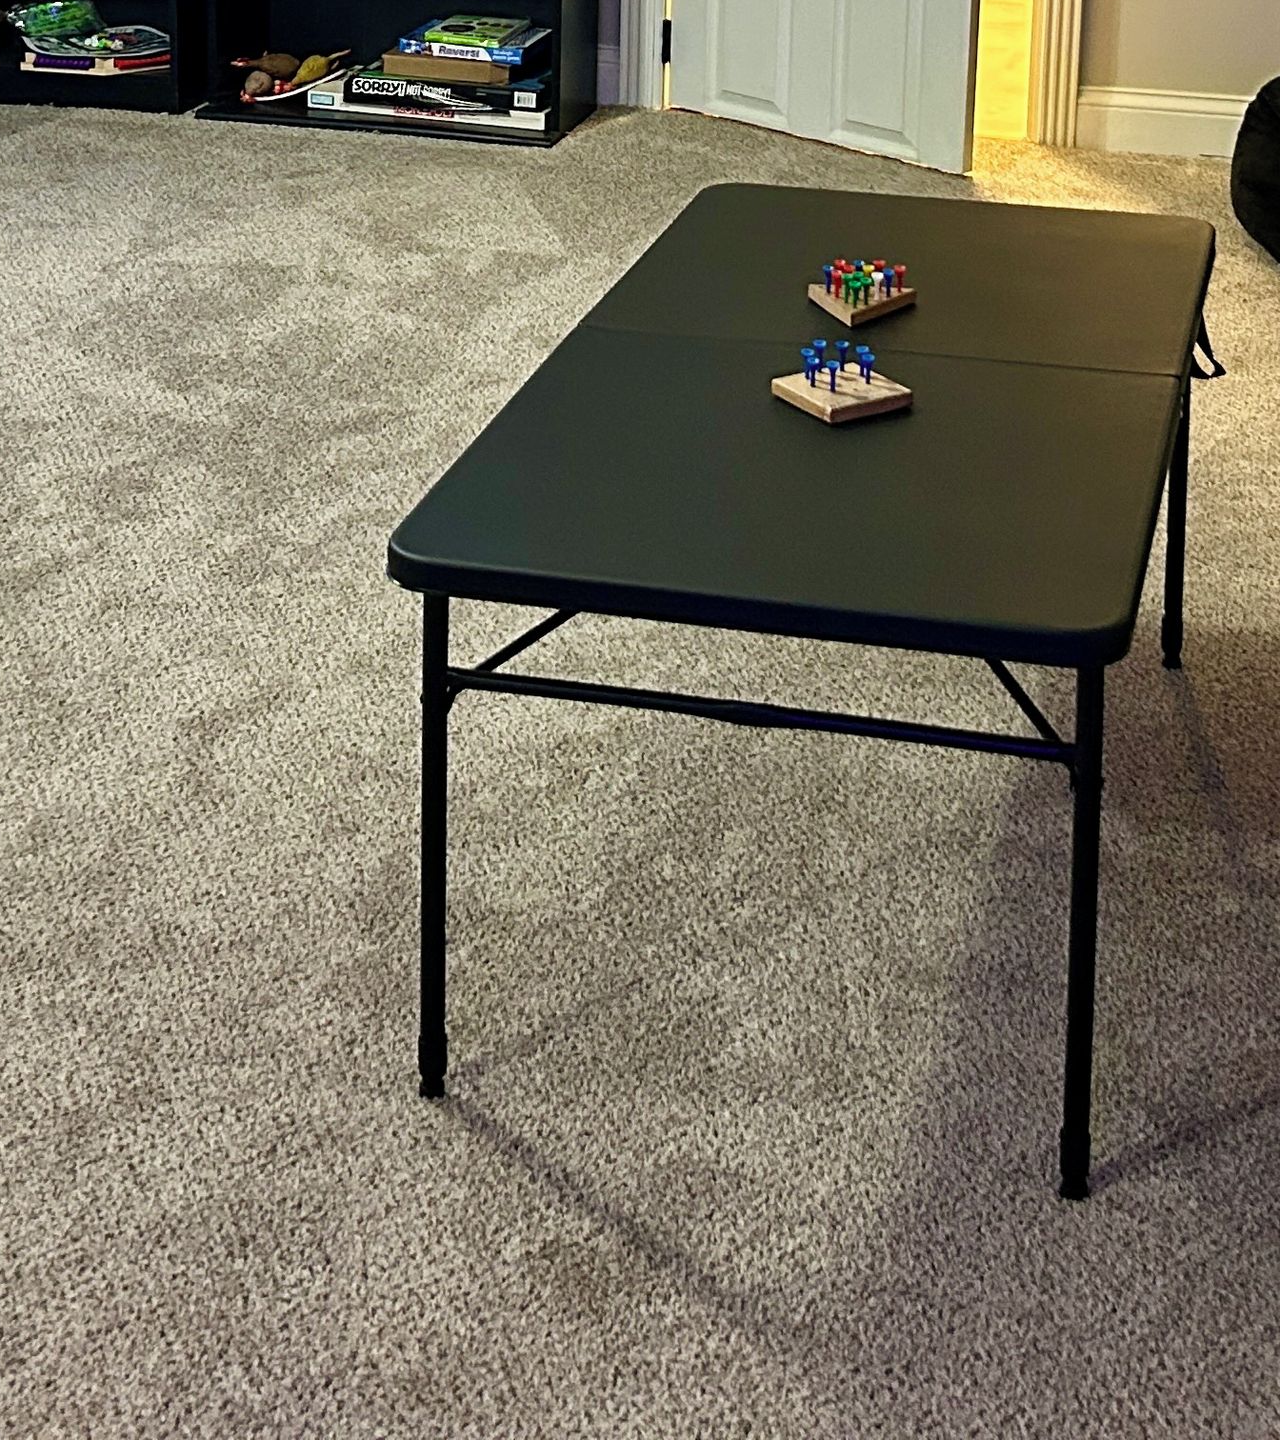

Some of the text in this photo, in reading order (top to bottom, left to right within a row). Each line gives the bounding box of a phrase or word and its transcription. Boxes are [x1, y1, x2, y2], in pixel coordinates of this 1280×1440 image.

[438, 46, 480, 58] Reversi
[351, 78, 406, 97] SORRY!
[406, 85, 421, 96] NOT
